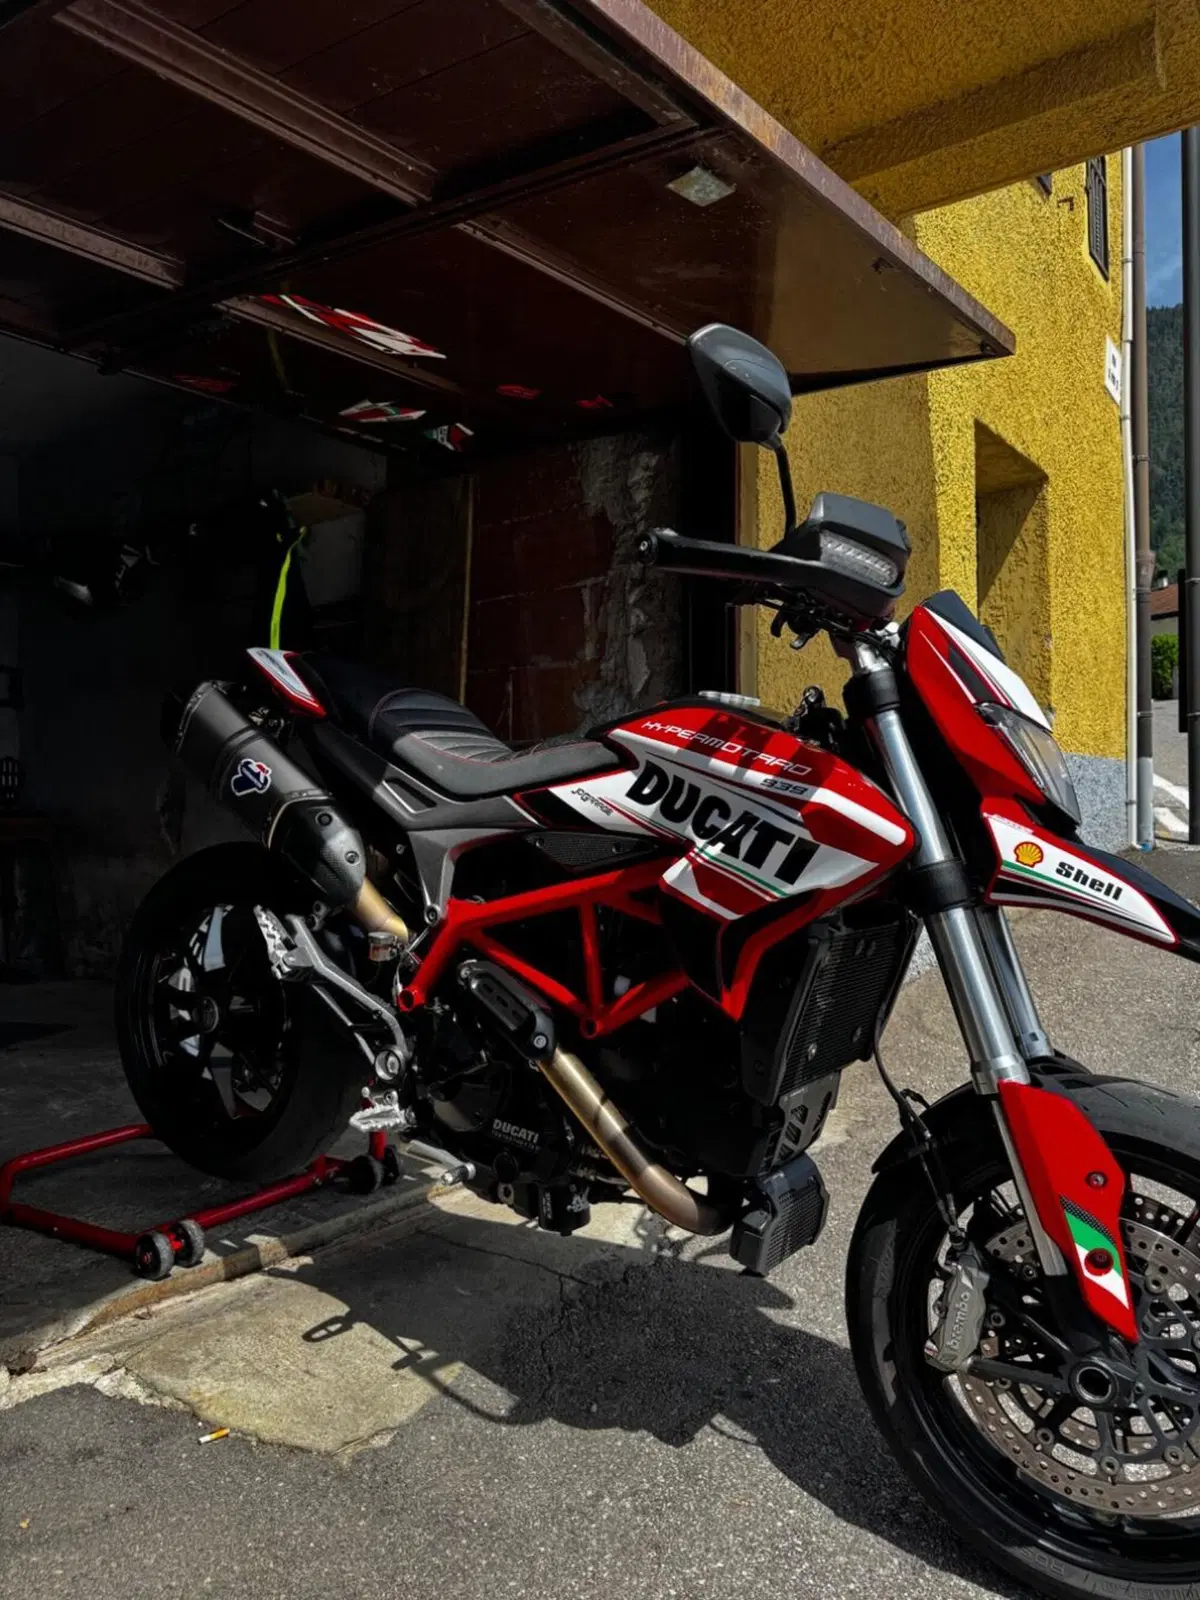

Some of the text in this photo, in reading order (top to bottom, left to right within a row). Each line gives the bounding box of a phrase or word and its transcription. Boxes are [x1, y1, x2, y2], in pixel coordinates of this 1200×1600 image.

[641, 721, 812, 776] HYPERMOTARD
[626, 760, 820, 885] DUCATI
[1055, 861, 1123, 901] Shell
[492, 1118, 540, 1145] DUCATI
[946, 1292, 971, 1350] brembo
